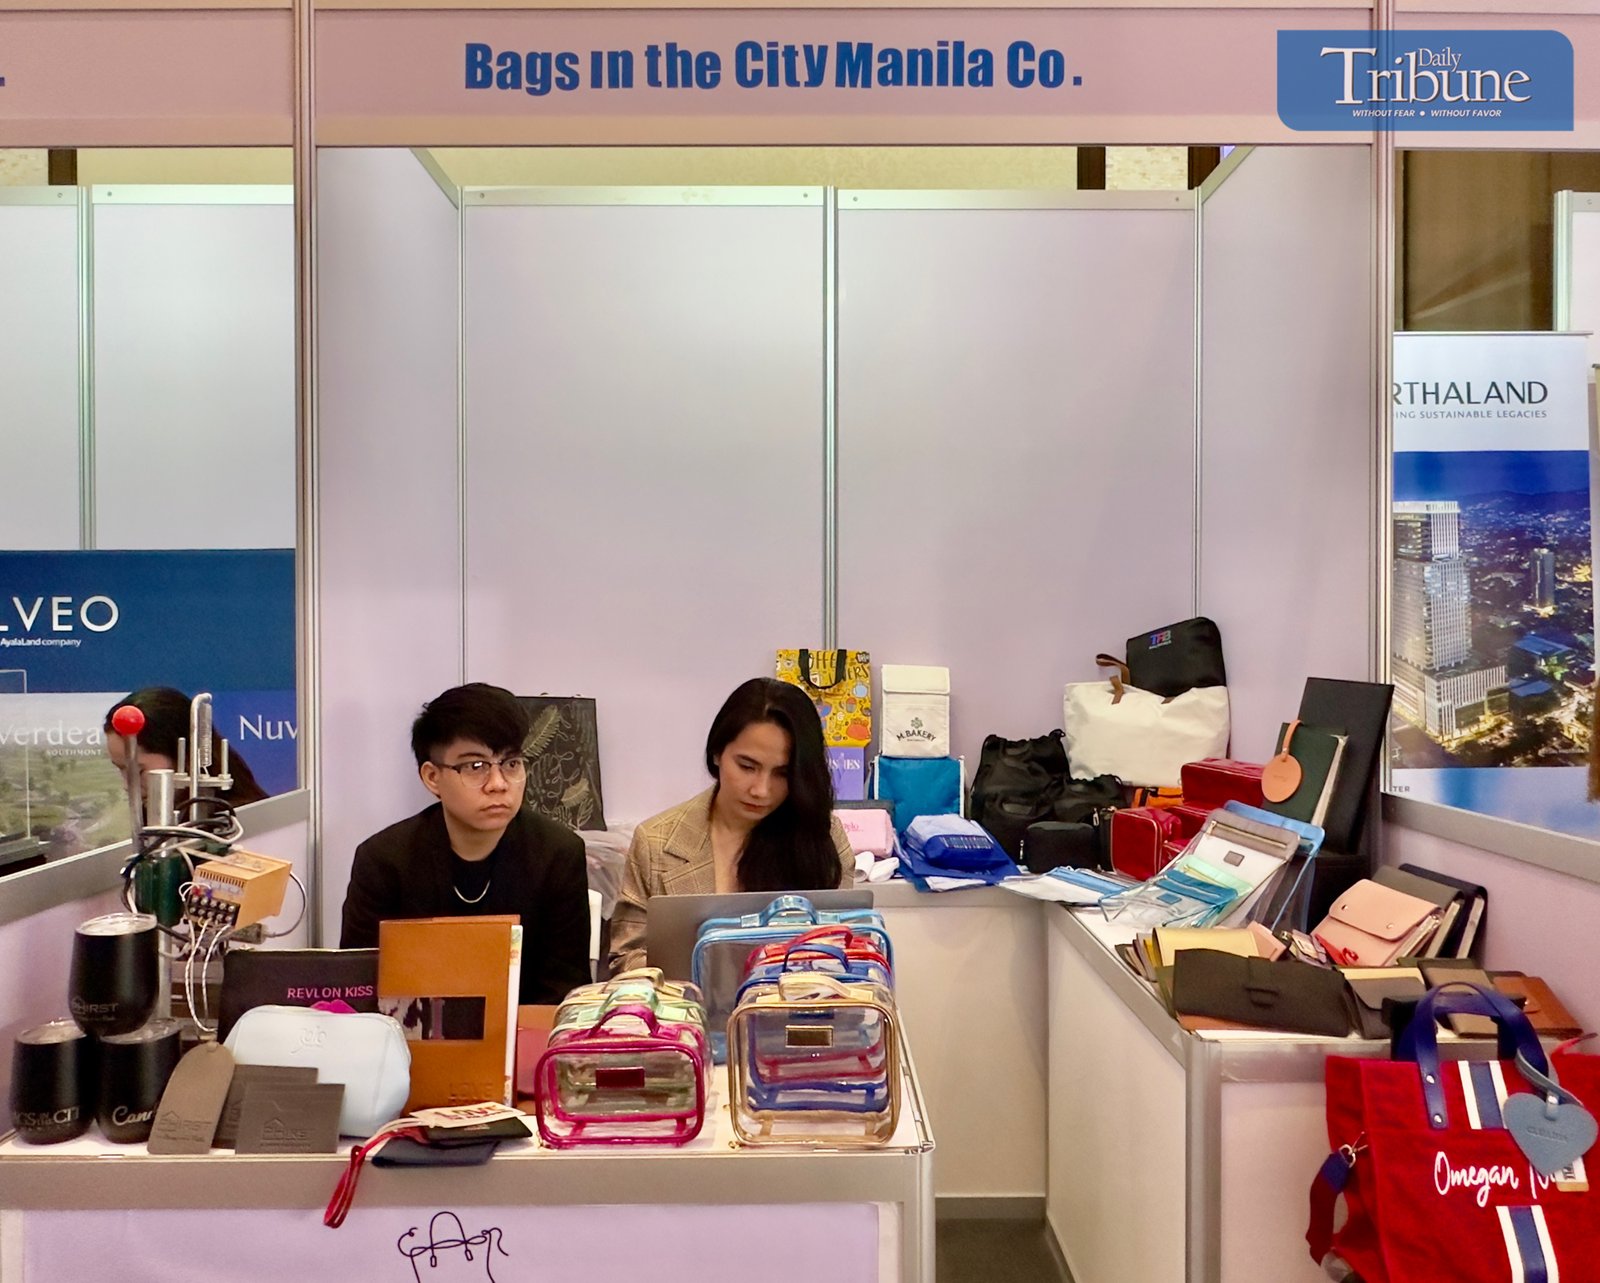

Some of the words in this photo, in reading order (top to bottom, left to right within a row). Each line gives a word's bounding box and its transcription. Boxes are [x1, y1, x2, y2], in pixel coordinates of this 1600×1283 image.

[464, 43, 580, 97] Bags
[590, 50, 634, 88] in
[645, 42, 721, 89] the
[735, 40, 828, 88] City
[835, 41, 994, 88] Manila
[1007, 40, 1082, 88] Co.
[1392, 381, 1548, 405] RTHALAND
[1394, 410, 1416, 419] ING
[1420, 410, 1493, 419] SUSTAINABLE
[1496, 410, 1548, 419] LEGACIES
[240, 714, 298, 740] Nuv
[1392, 785, 1410, 793] TER
[287, 986, 342, 999] REVLON
[344, 985, 374, 998] KISS
[1434, 1151, 1520, 1208] Omegan
